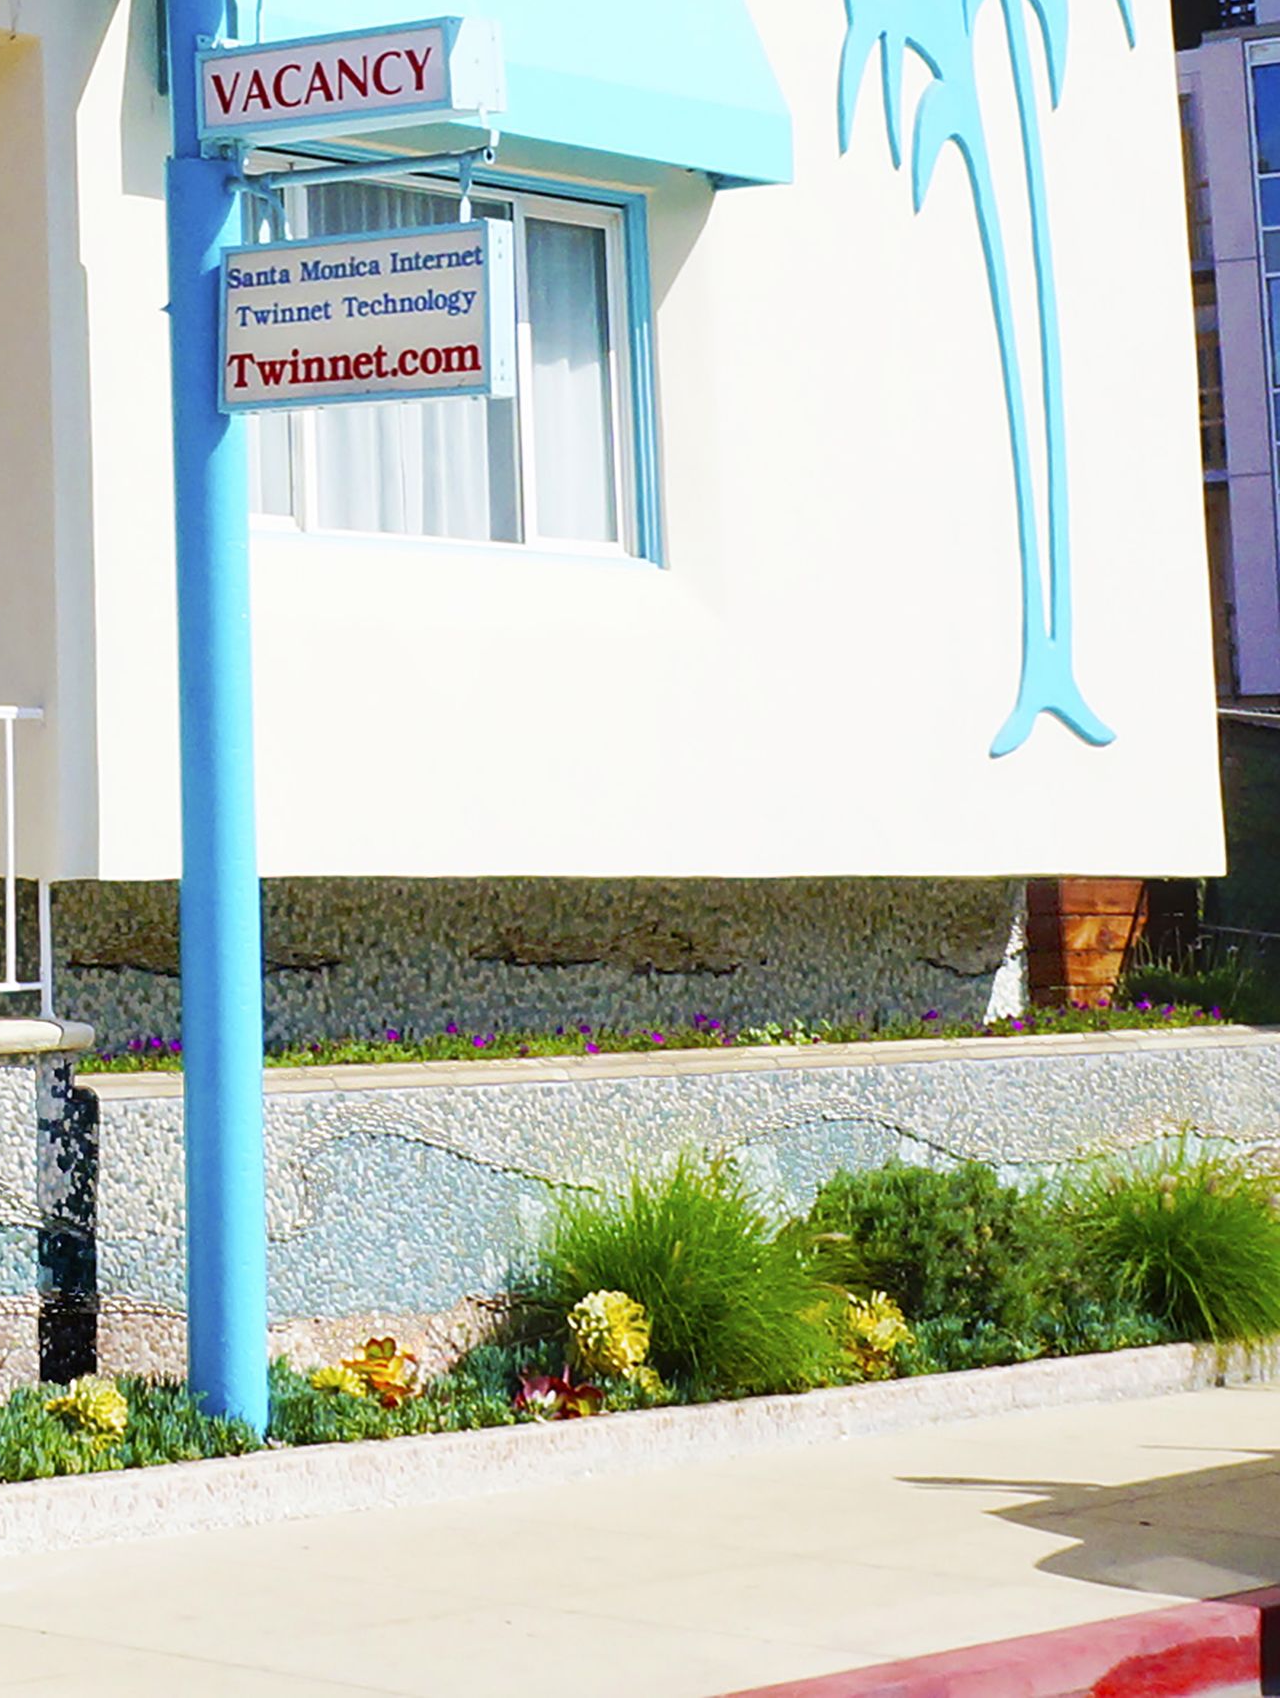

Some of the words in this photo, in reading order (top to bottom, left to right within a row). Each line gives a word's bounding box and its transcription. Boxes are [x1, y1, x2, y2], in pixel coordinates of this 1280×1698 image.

[211, 47, 433, 115] VACANCY
[226, 267, 290, 289] Santa
[300, 256, 381, 282] Monica
[390, 246, 483, 274] Internet
[236, 301, 332, 327] Twinnet
[342, 289, 477, 317] Technology
[227, 345, 482, 388] Twinnet.com
